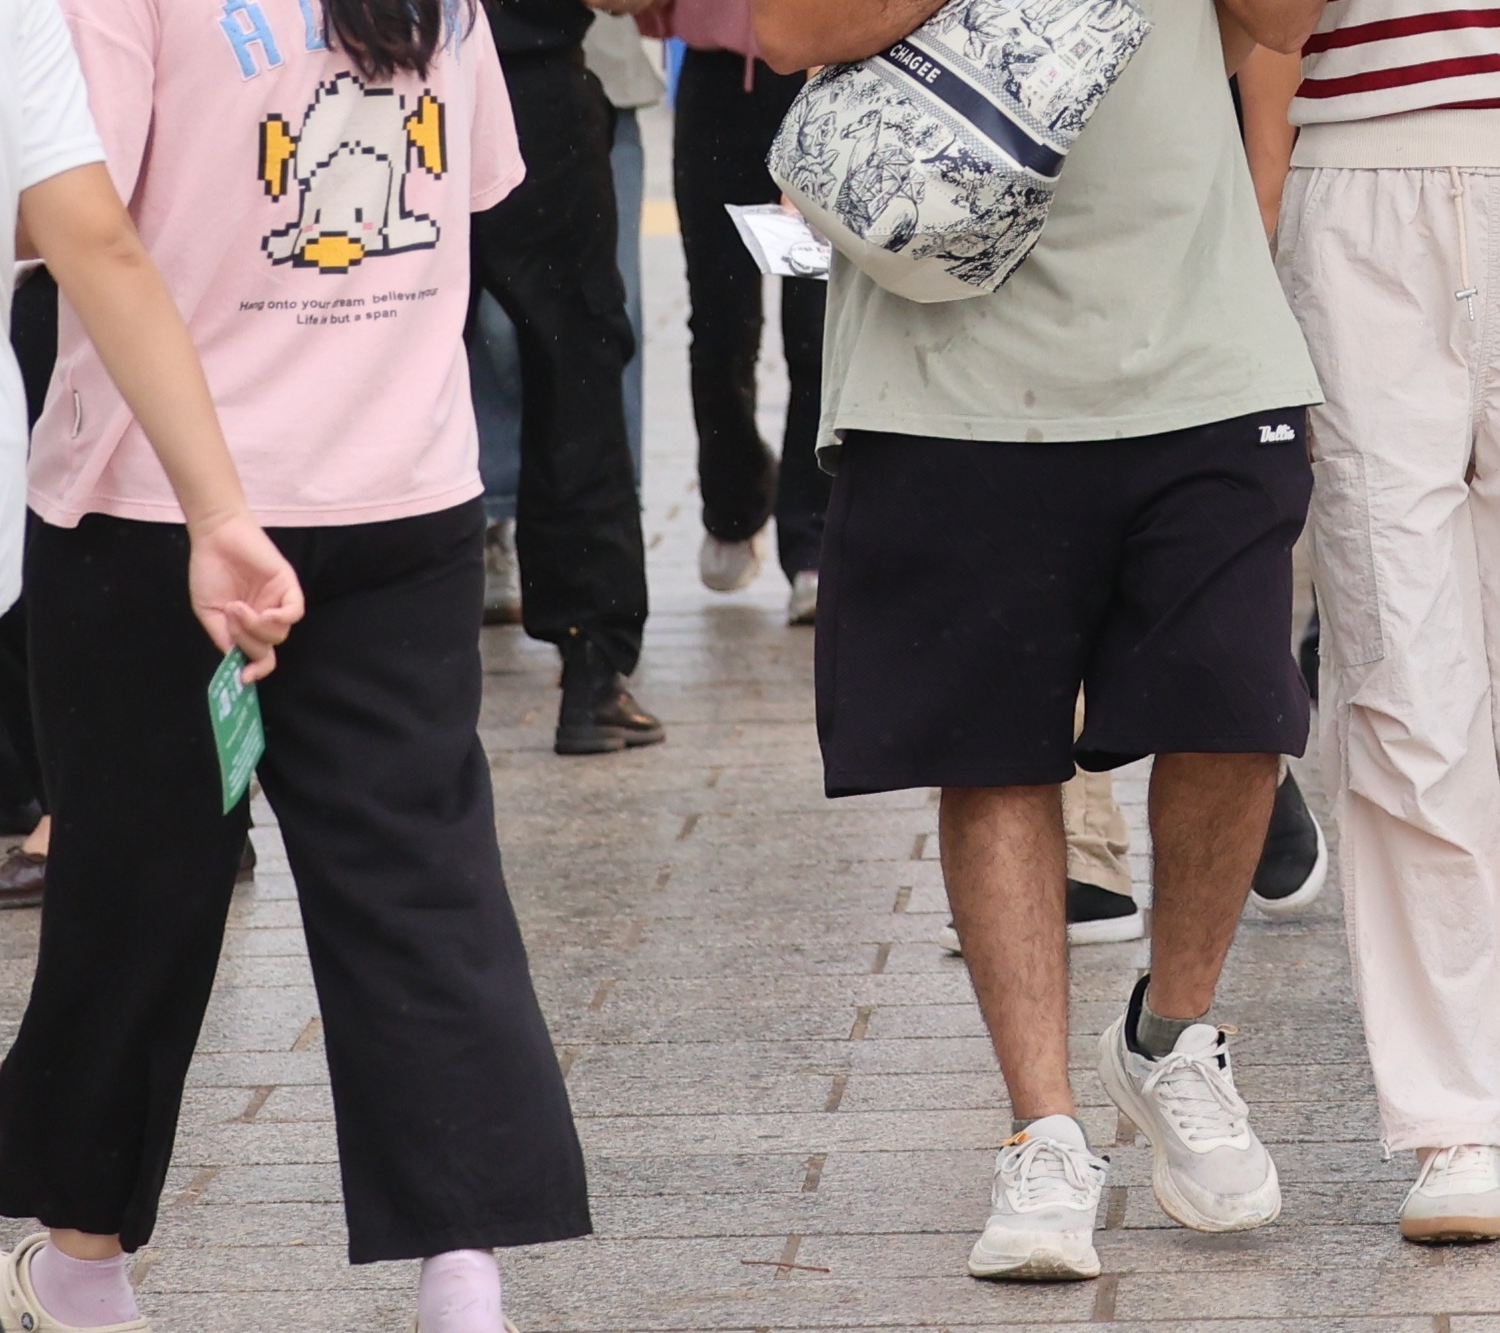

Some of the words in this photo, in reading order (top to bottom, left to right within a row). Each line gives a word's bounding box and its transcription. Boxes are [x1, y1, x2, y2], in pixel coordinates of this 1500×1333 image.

[889, 43, 942, 84] CHAGEE
[267, 298, 298, 310] onto
[301, 300, 331, 311] your
[372, 290, 417, 304] believe
[296, 314, 319, 325] Life
[329, 313, 351, 324] but
[365, 309, 398, 321] span
